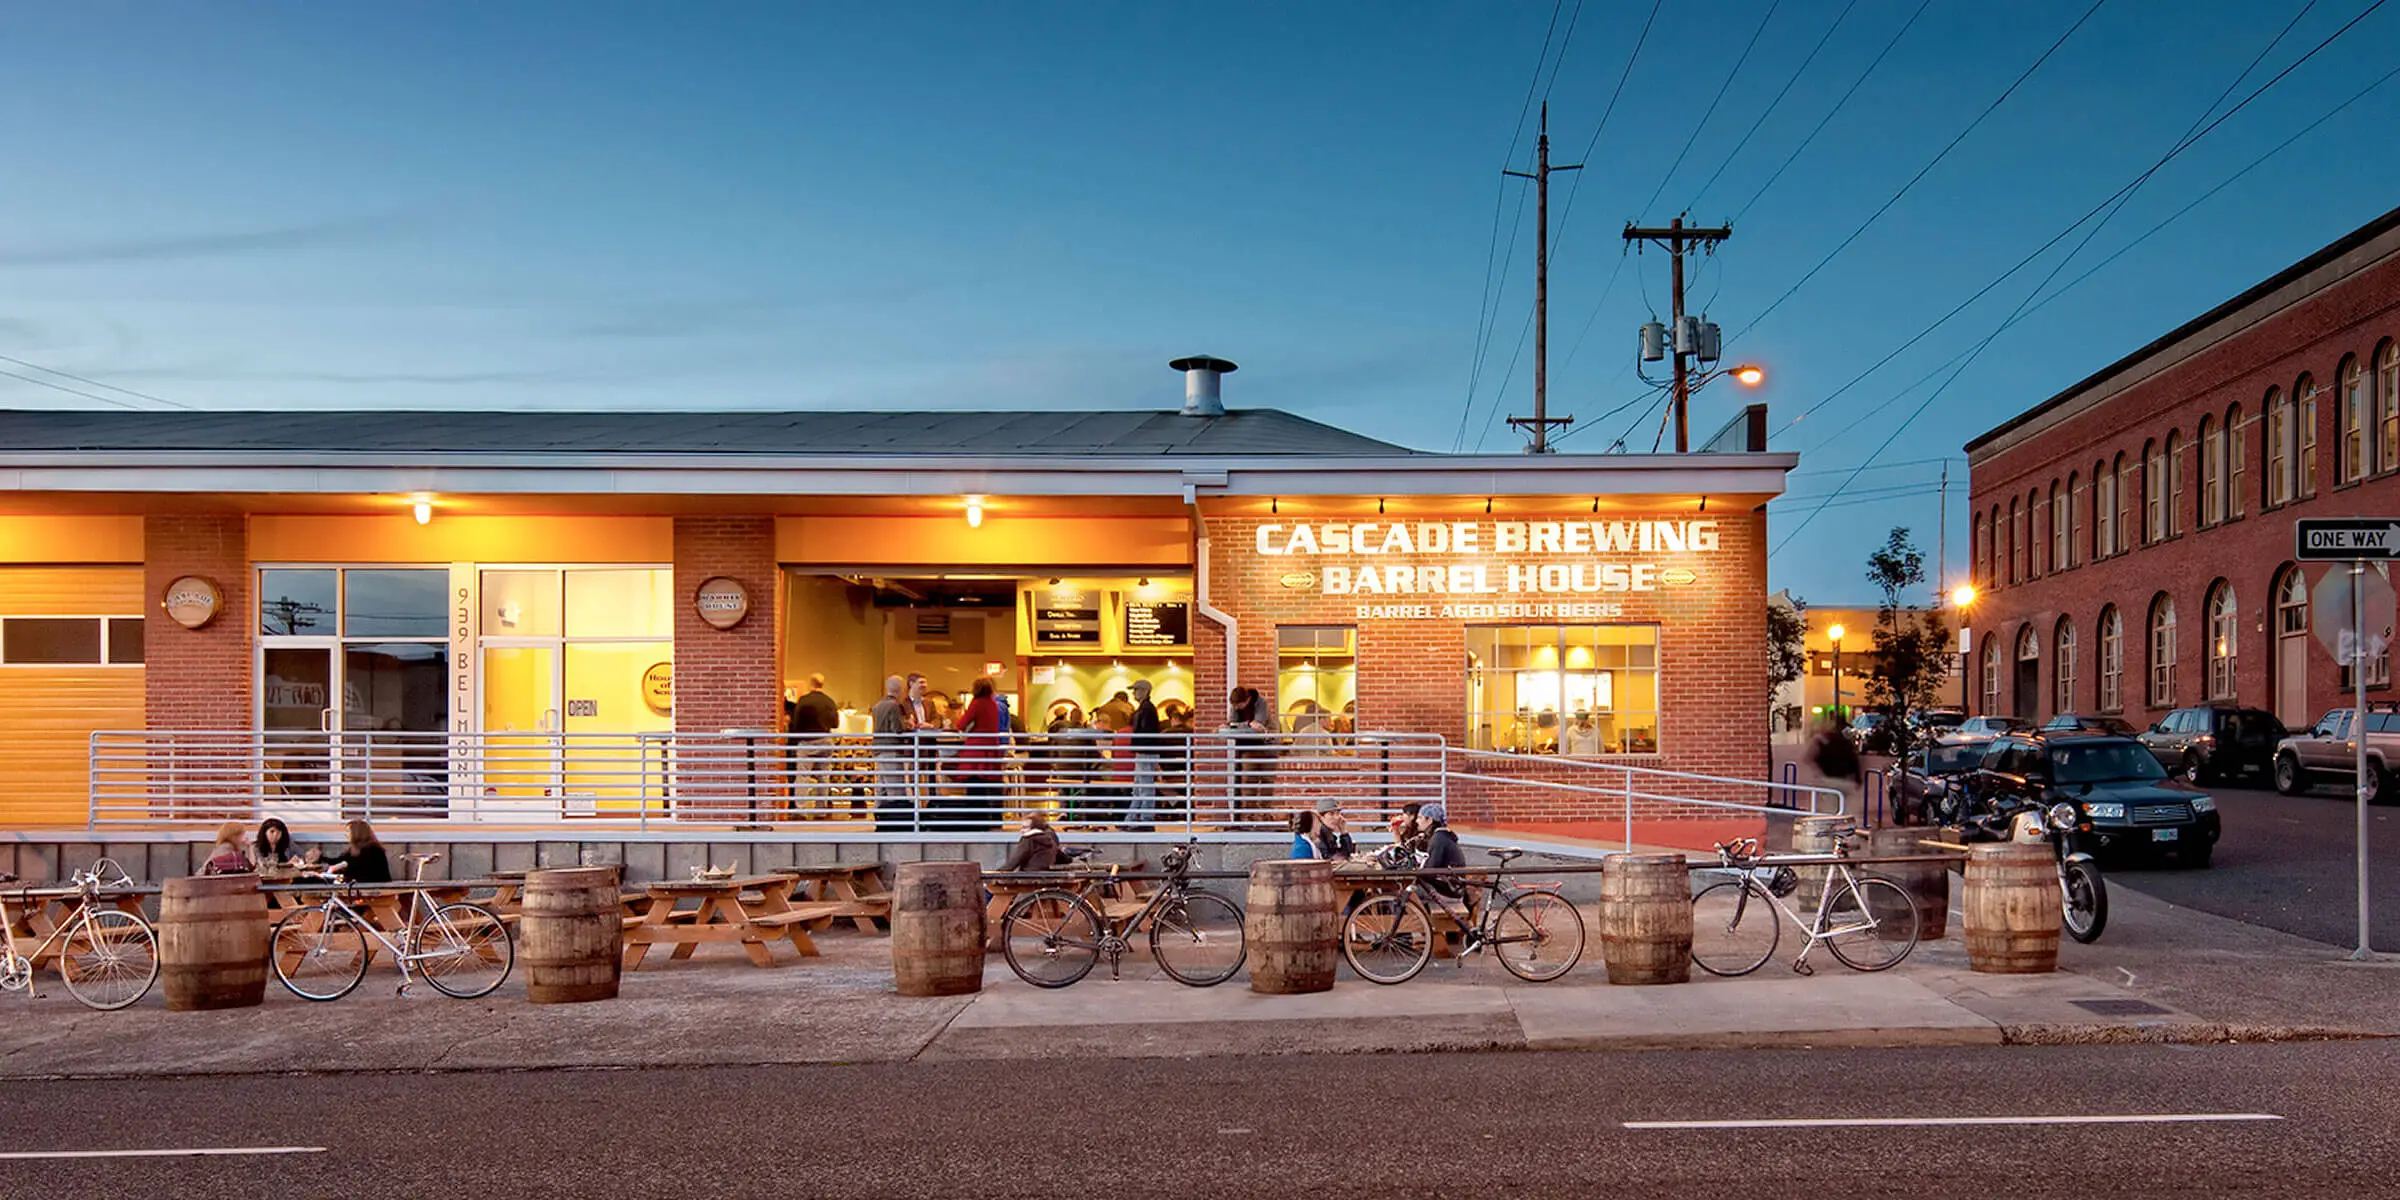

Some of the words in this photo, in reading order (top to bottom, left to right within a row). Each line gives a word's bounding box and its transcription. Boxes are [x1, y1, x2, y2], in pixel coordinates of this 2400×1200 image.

[1256, 522, 1478, 555] CASCADE
[1495, 521, 1720, 553] BREWING
[2311, 531, 2345, 547] ONE
[2352, 531, 2386, 547] WAY
[1322, 564, 1498, 595] BARREL
[1507, 563, 1656, 593] HOUSE
[458, 588, 469, 644] 939
[1356, 604, 1437, 619] BARREL
[1440, 604, 1494, 618] AGED
[1496, 603, 1556, 618] SOUR
[1556, 602, 1623, 617] BEERS
[568, 700, 597, 716] OPEN
